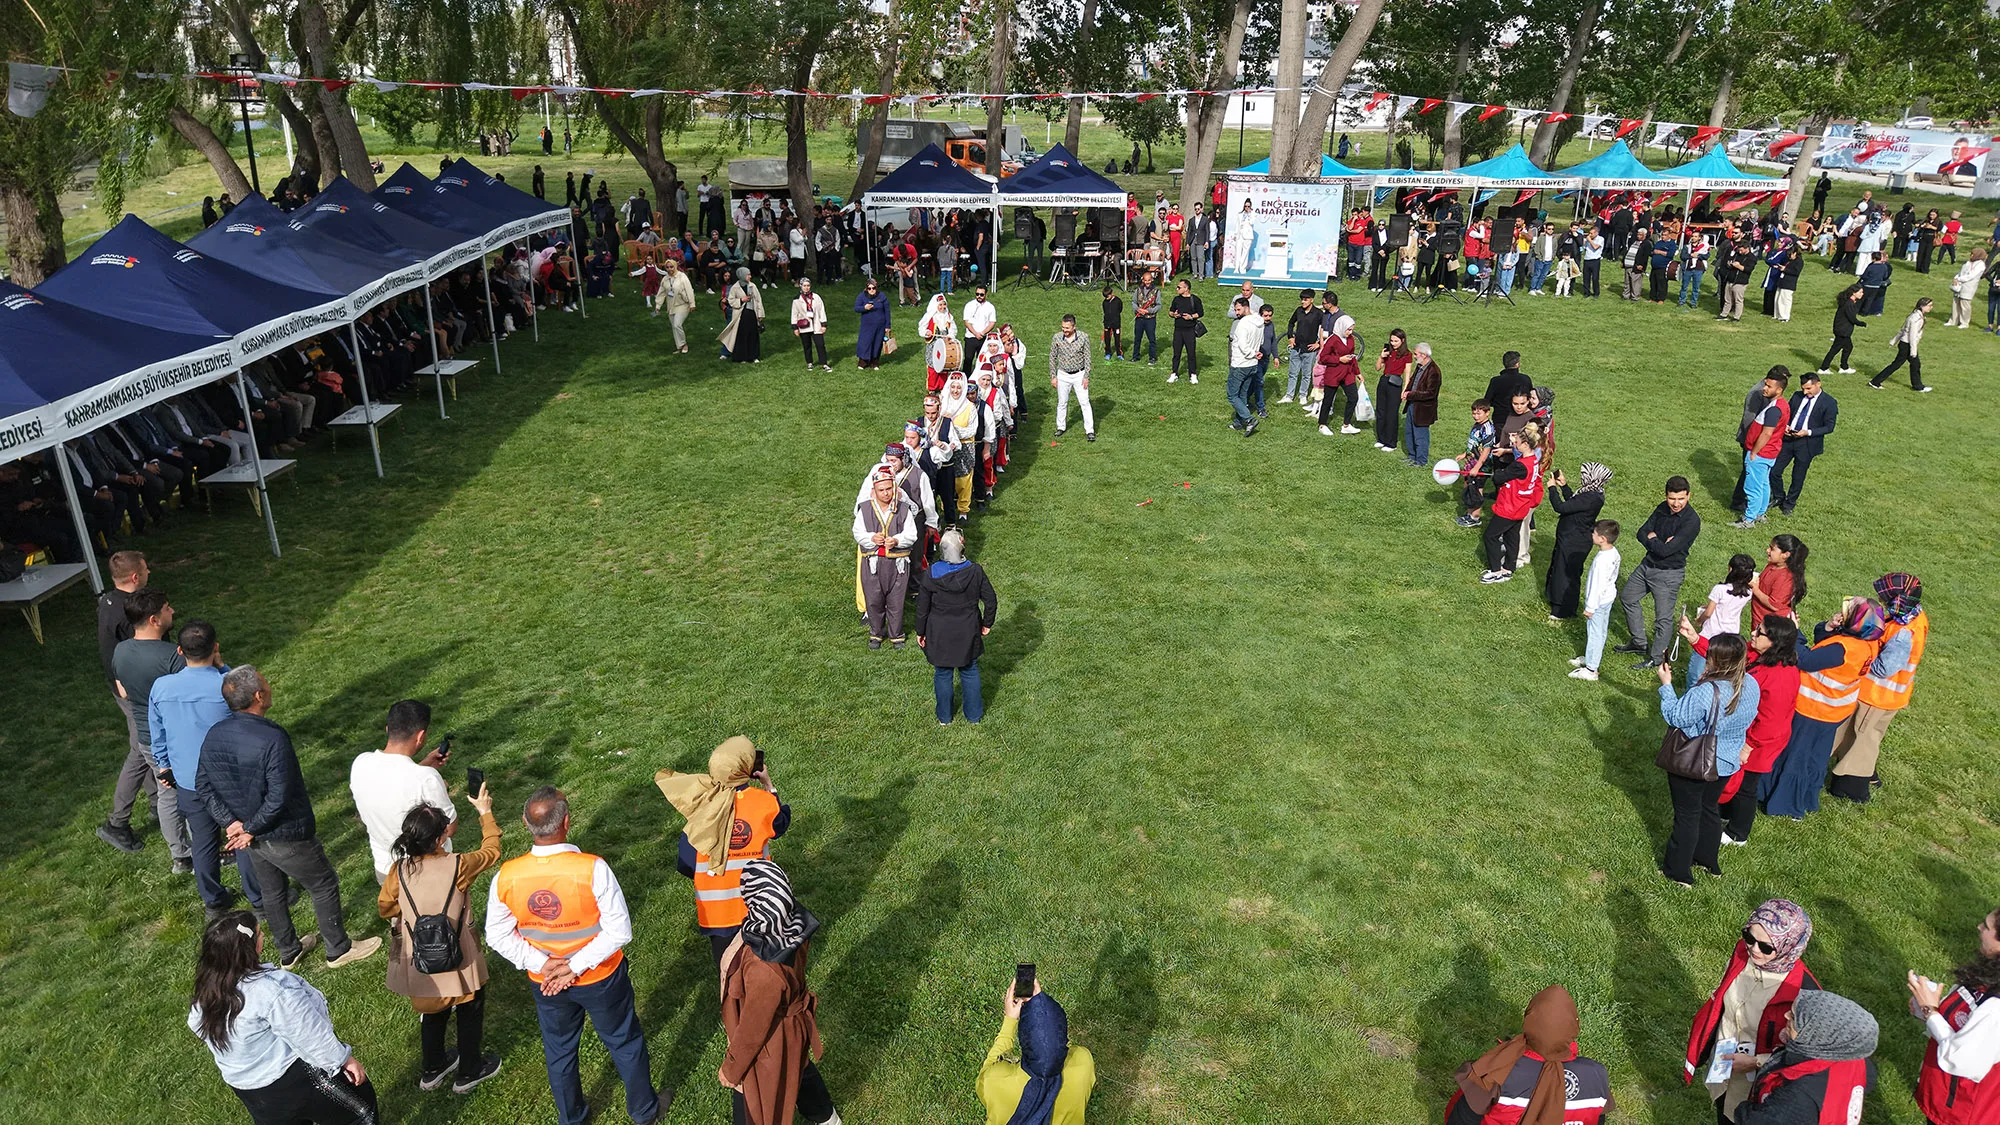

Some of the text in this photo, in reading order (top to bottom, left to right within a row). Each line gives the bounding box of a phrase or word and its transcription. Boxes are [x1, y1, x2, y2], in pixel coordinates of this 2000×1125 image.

[871, 194, 991, 205] KAHRAMANMARAŞ BÜYÜKŞEHİR BELEDİYESİ
[1261, 199, 1308, 209] ENGELSİZ
[65, 351, 233, 429] KAHRAMANMARAŞ BÜYÜKŞEHİR BELEDİYESİ
